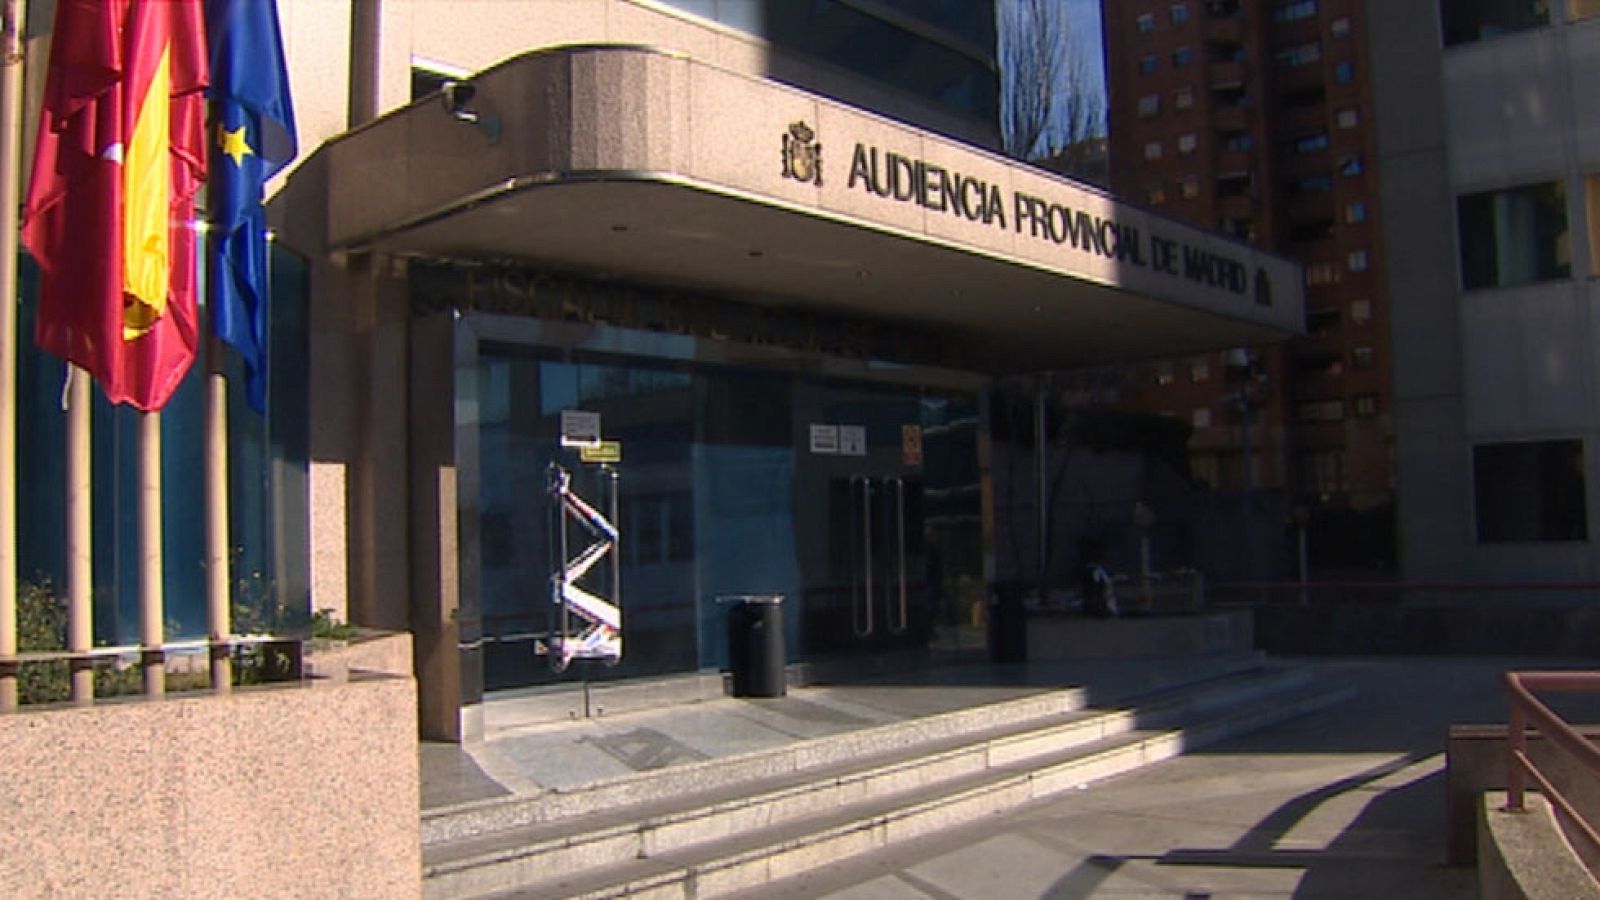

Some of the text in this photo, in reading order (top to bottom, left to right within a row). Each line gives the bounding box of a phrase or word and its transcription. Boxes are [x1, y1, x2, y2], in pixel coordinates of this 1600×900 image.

[848, 143, 1248, 296] AUDIENCIA PROVINCIAL DE MADRID
